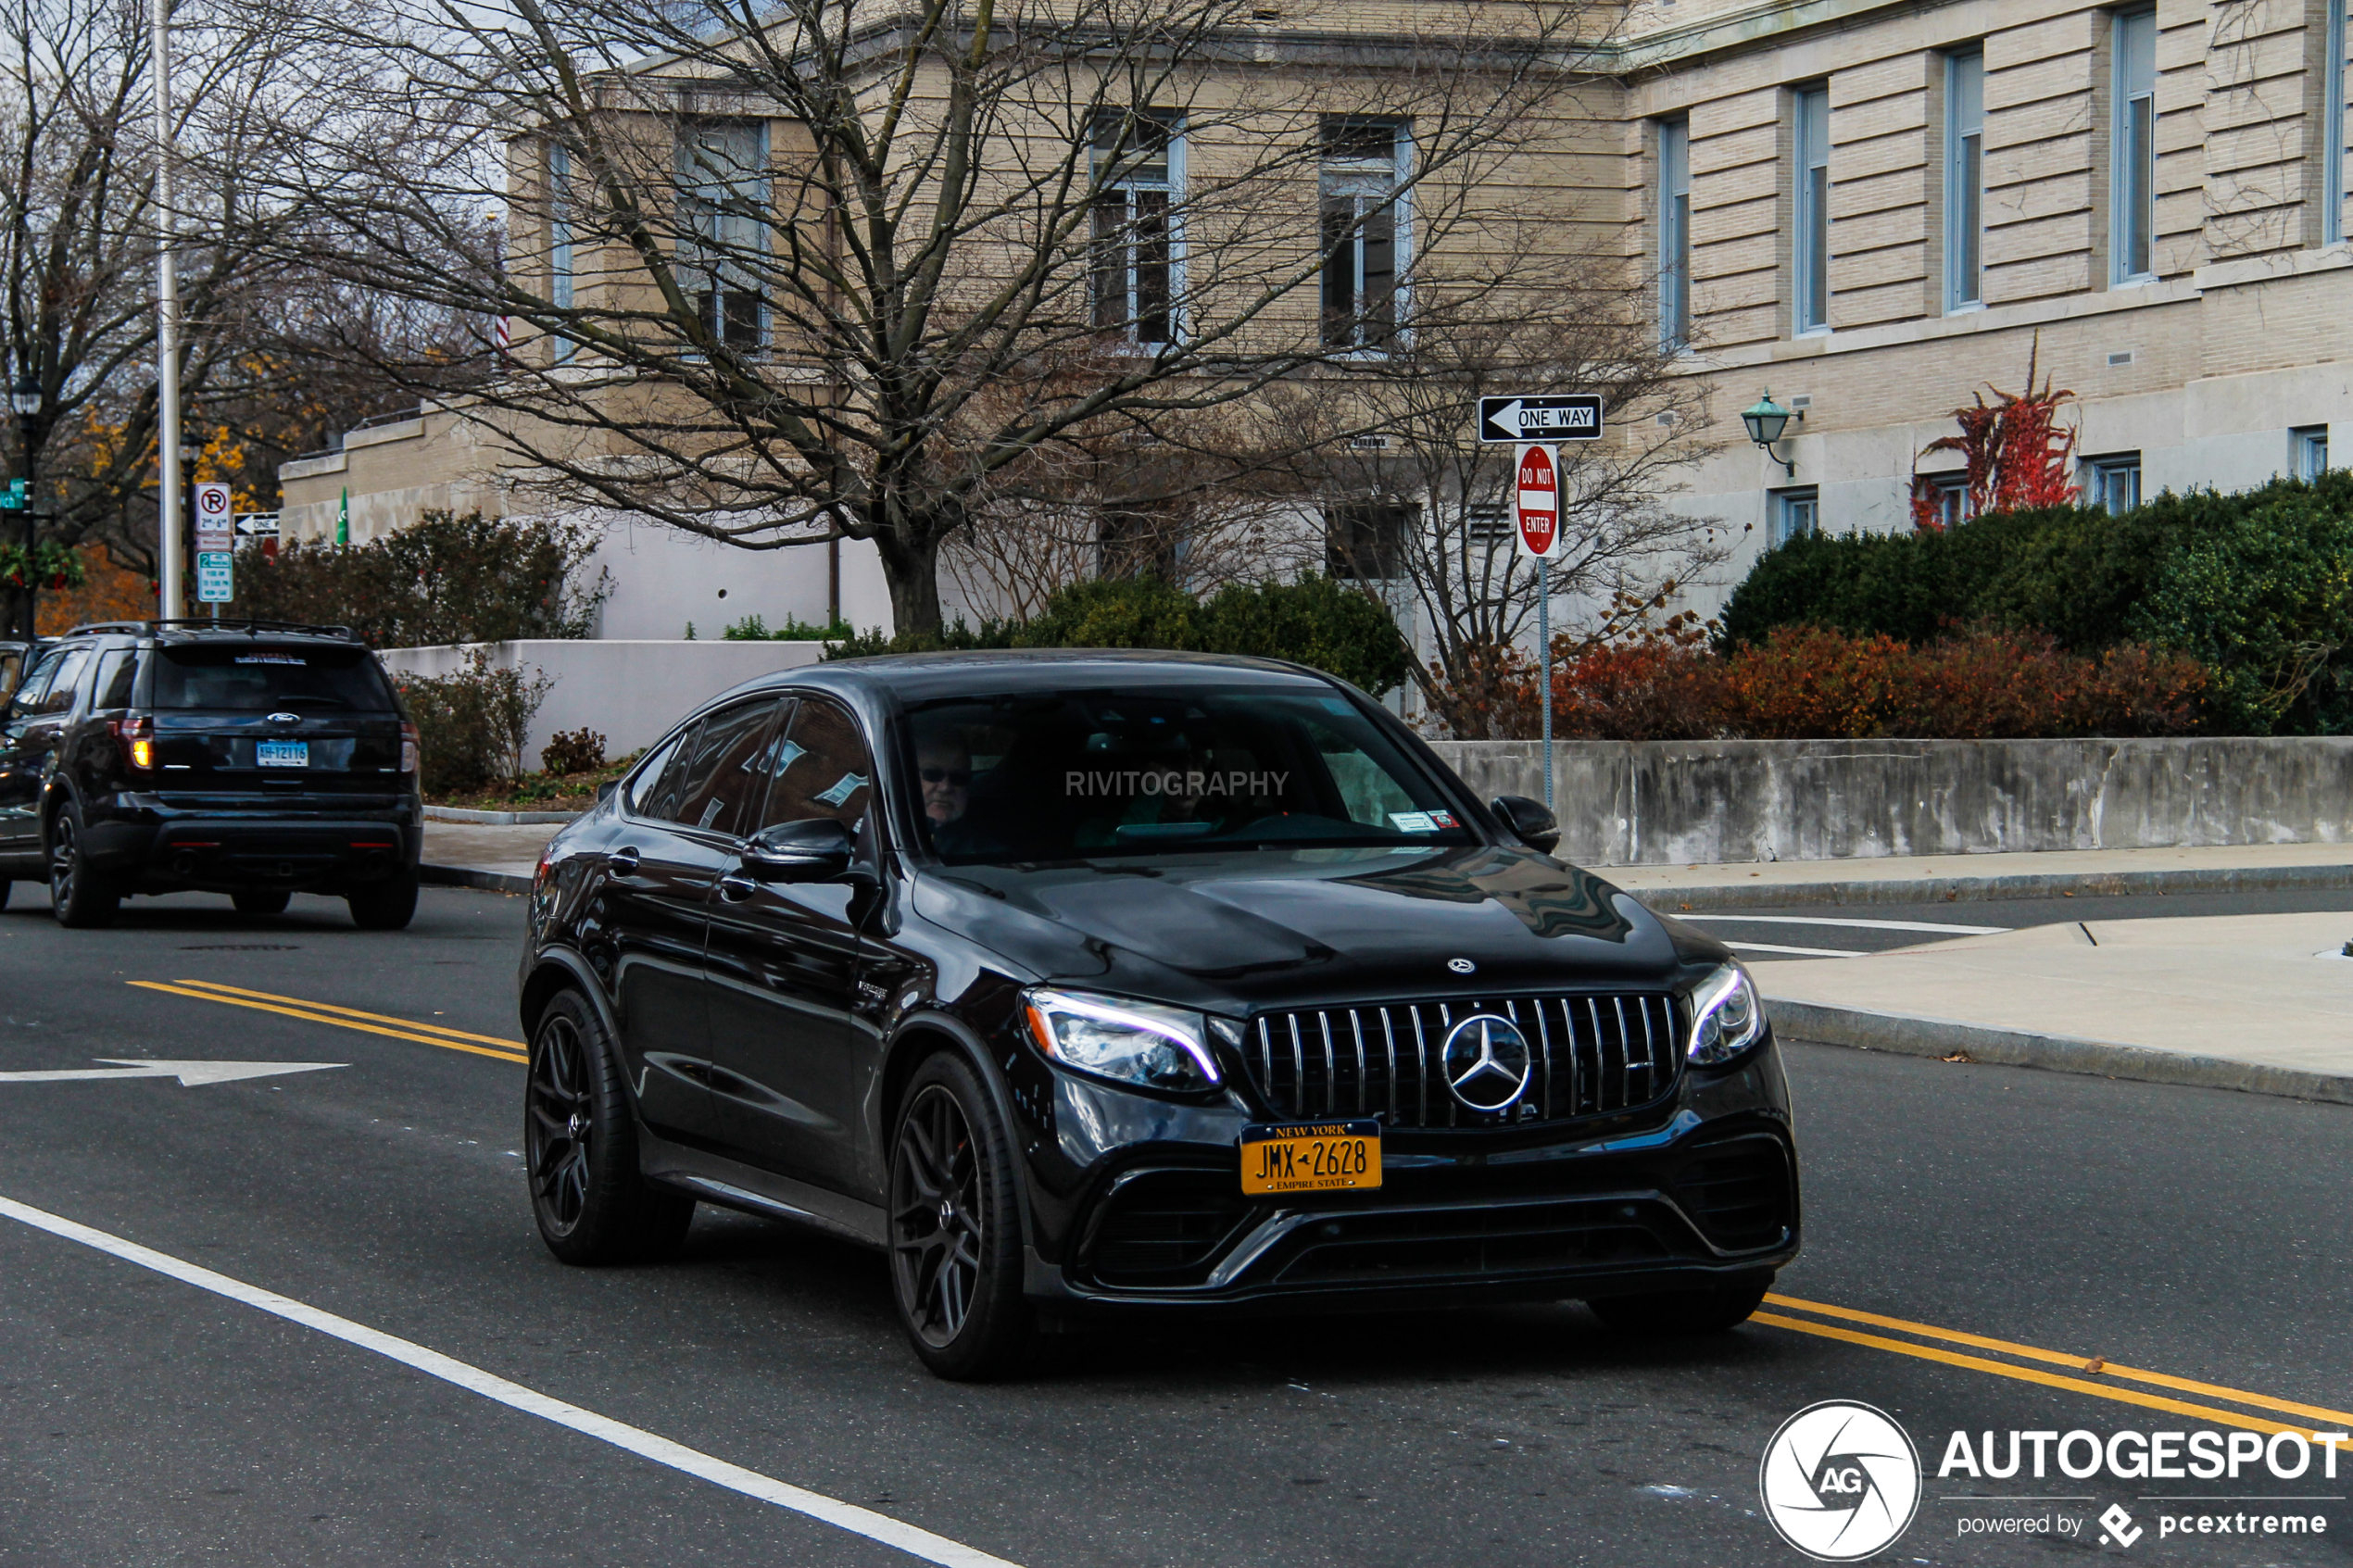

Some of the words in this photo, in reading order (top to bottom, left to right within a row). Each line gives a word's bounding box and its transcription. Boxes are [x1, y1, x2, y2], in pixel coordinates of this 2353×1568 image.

[1518, 410, 1550, 427] ONE
[1558, 408, 1592, 425] WAY
[1521, 468, 1533, 484] DO
[1537, 468, 1552, 485] NOT
[254, 519, 271, 529] ONE
[1526, 516, 1550, 533] ENTER
[201, 555, 209, 567] 2
[1276, 1126, 1308, 1138] NEW
[1311, 1123, 1346, 1136] YORK
[1277, 1180, 1315, 1190] EMPIRE
[1317, 1178, 1348, 1187] STATE
